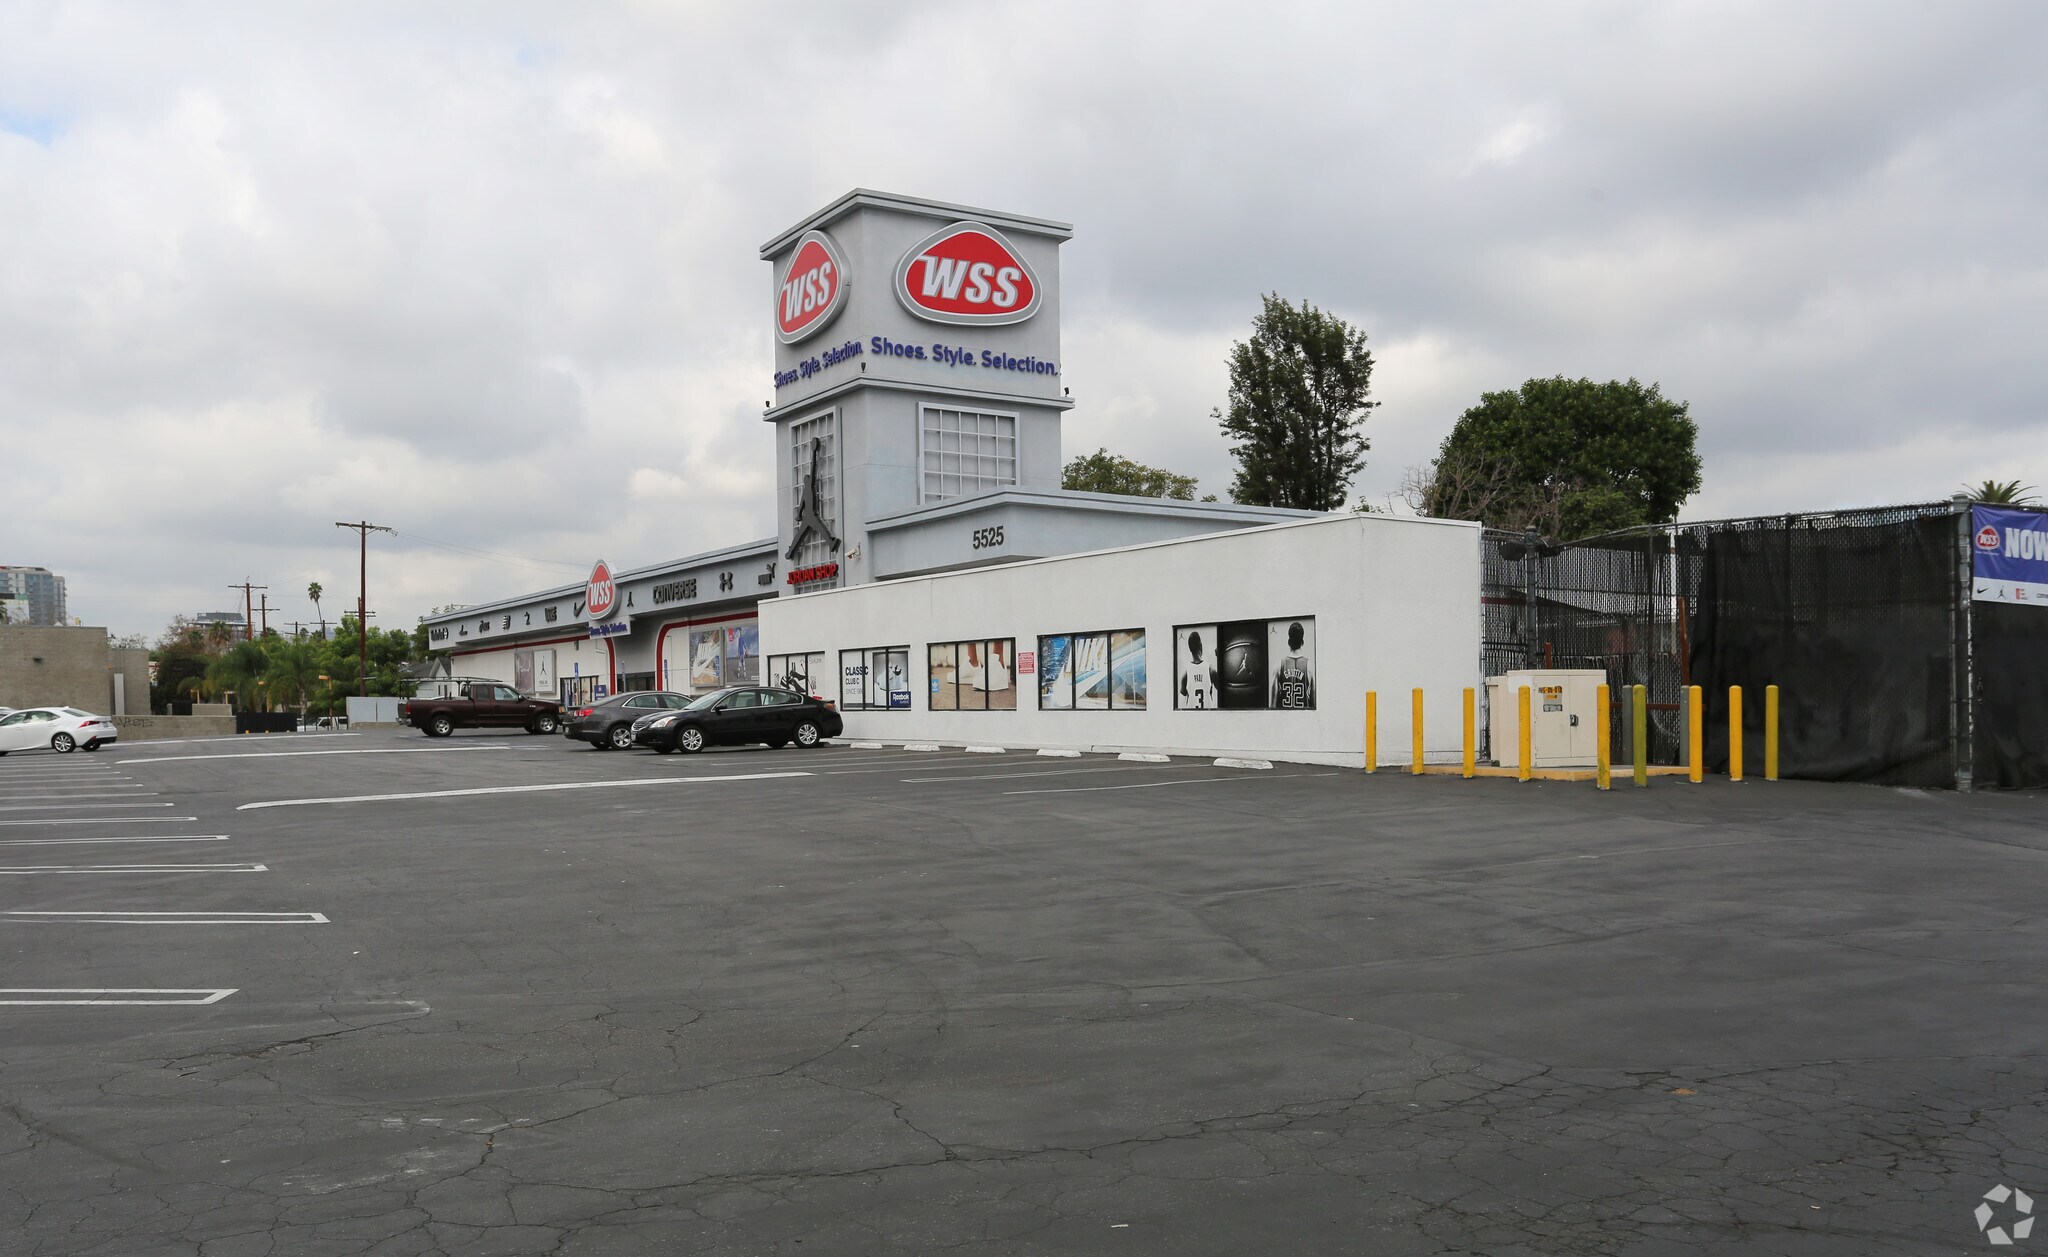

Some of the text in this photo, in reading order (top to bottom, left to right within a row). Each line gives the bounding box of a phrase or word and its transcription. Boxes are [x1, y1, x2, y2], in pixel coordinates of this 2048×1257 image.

[783, 260, 832, 323] WSS
[916, 253, 1022, 308] WSS
[822, 341, 863, 369] Selection.
[871, 336, 1059, 376] Shoes. Style. Selection.
[973, 525, 1004, 550] 5525
[1980, 534, 1997, 544] WSS
[2005, 527, 2048, 562] NOW
[787, 564, 839, 585] JORDAN SHOP
[589, 579, 611, 607] WSS
[653, 578, 698, 604] CONVERSE
[845, 665, 869, 676] CLASSC
[892, 693, 910, 702] Reebok
[1194, 689, 1204, 708] 3
[1282, 682, 1304, 708] 32
